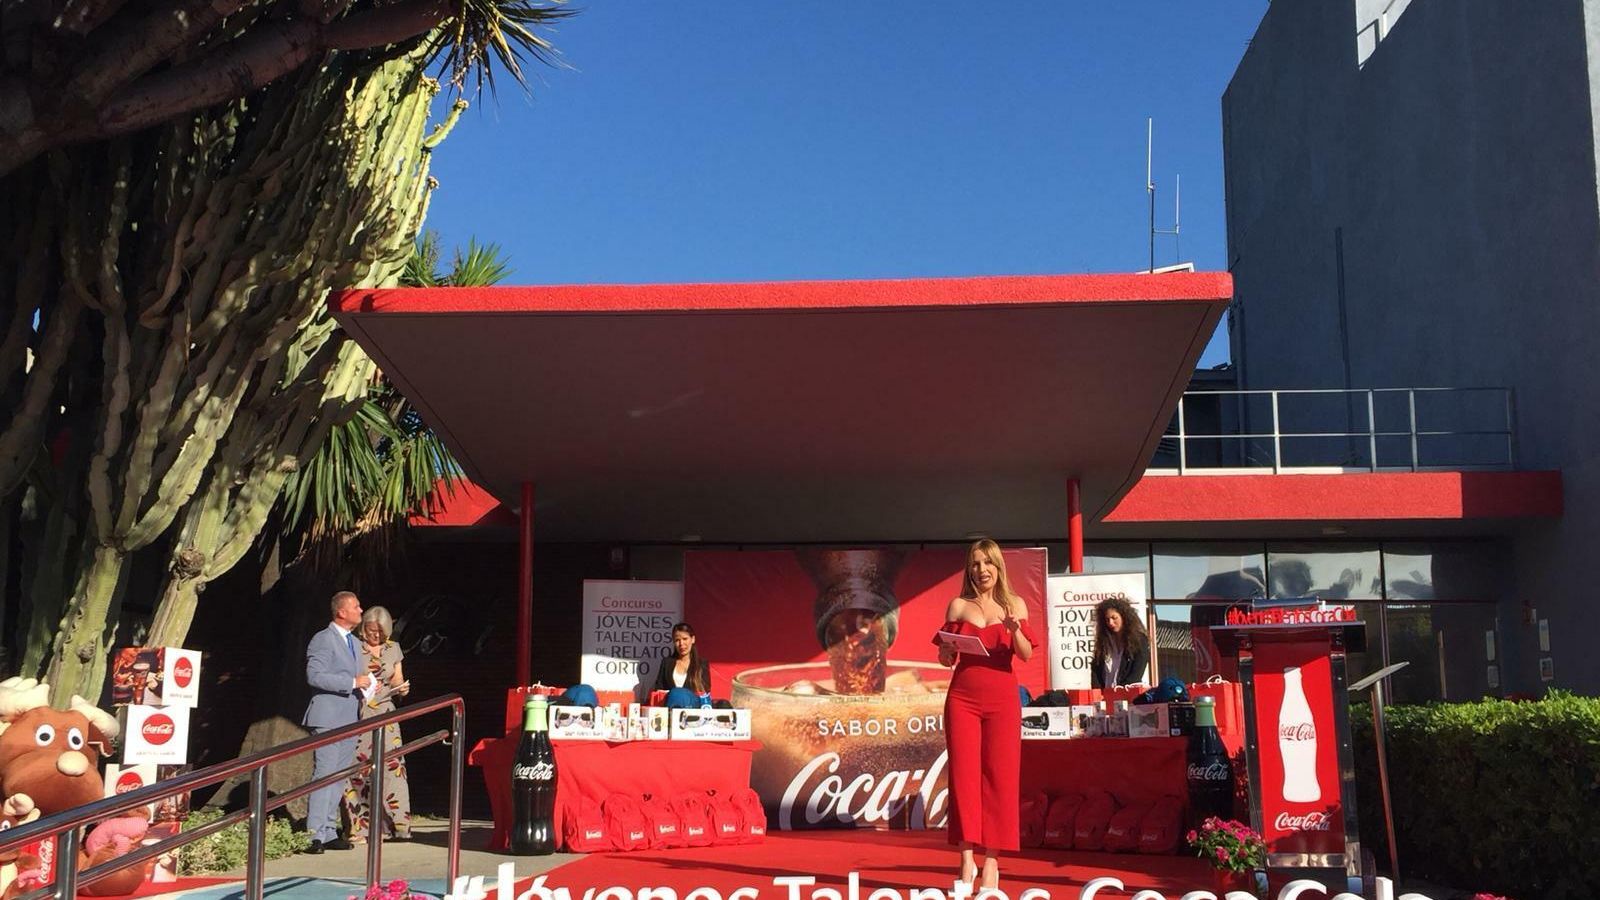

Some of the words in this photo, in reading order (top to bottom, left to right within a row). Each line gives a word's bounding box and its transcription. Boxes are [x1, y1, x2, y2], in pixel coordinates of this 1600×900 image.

[601, 596, 663, 609] Concurso
[1063, 590, 1126, 602] Concurso
[596, 612, 673, 630] JÓVENES
[1059, 607, 1097, 624] JÓVE
[594, 630, 674, 644] TALENTOS
[1058, 625, 1096, 638] TALE
[595, 647, 608, 656] DE
[611, 645, 673, 659] RELATO
[1061, 642, 1073, 651] DE
[595, 661, 650, 675] CORTO
[1061, 656, 1095, 670] COR
[818, 718, 898, 737] SABOR
